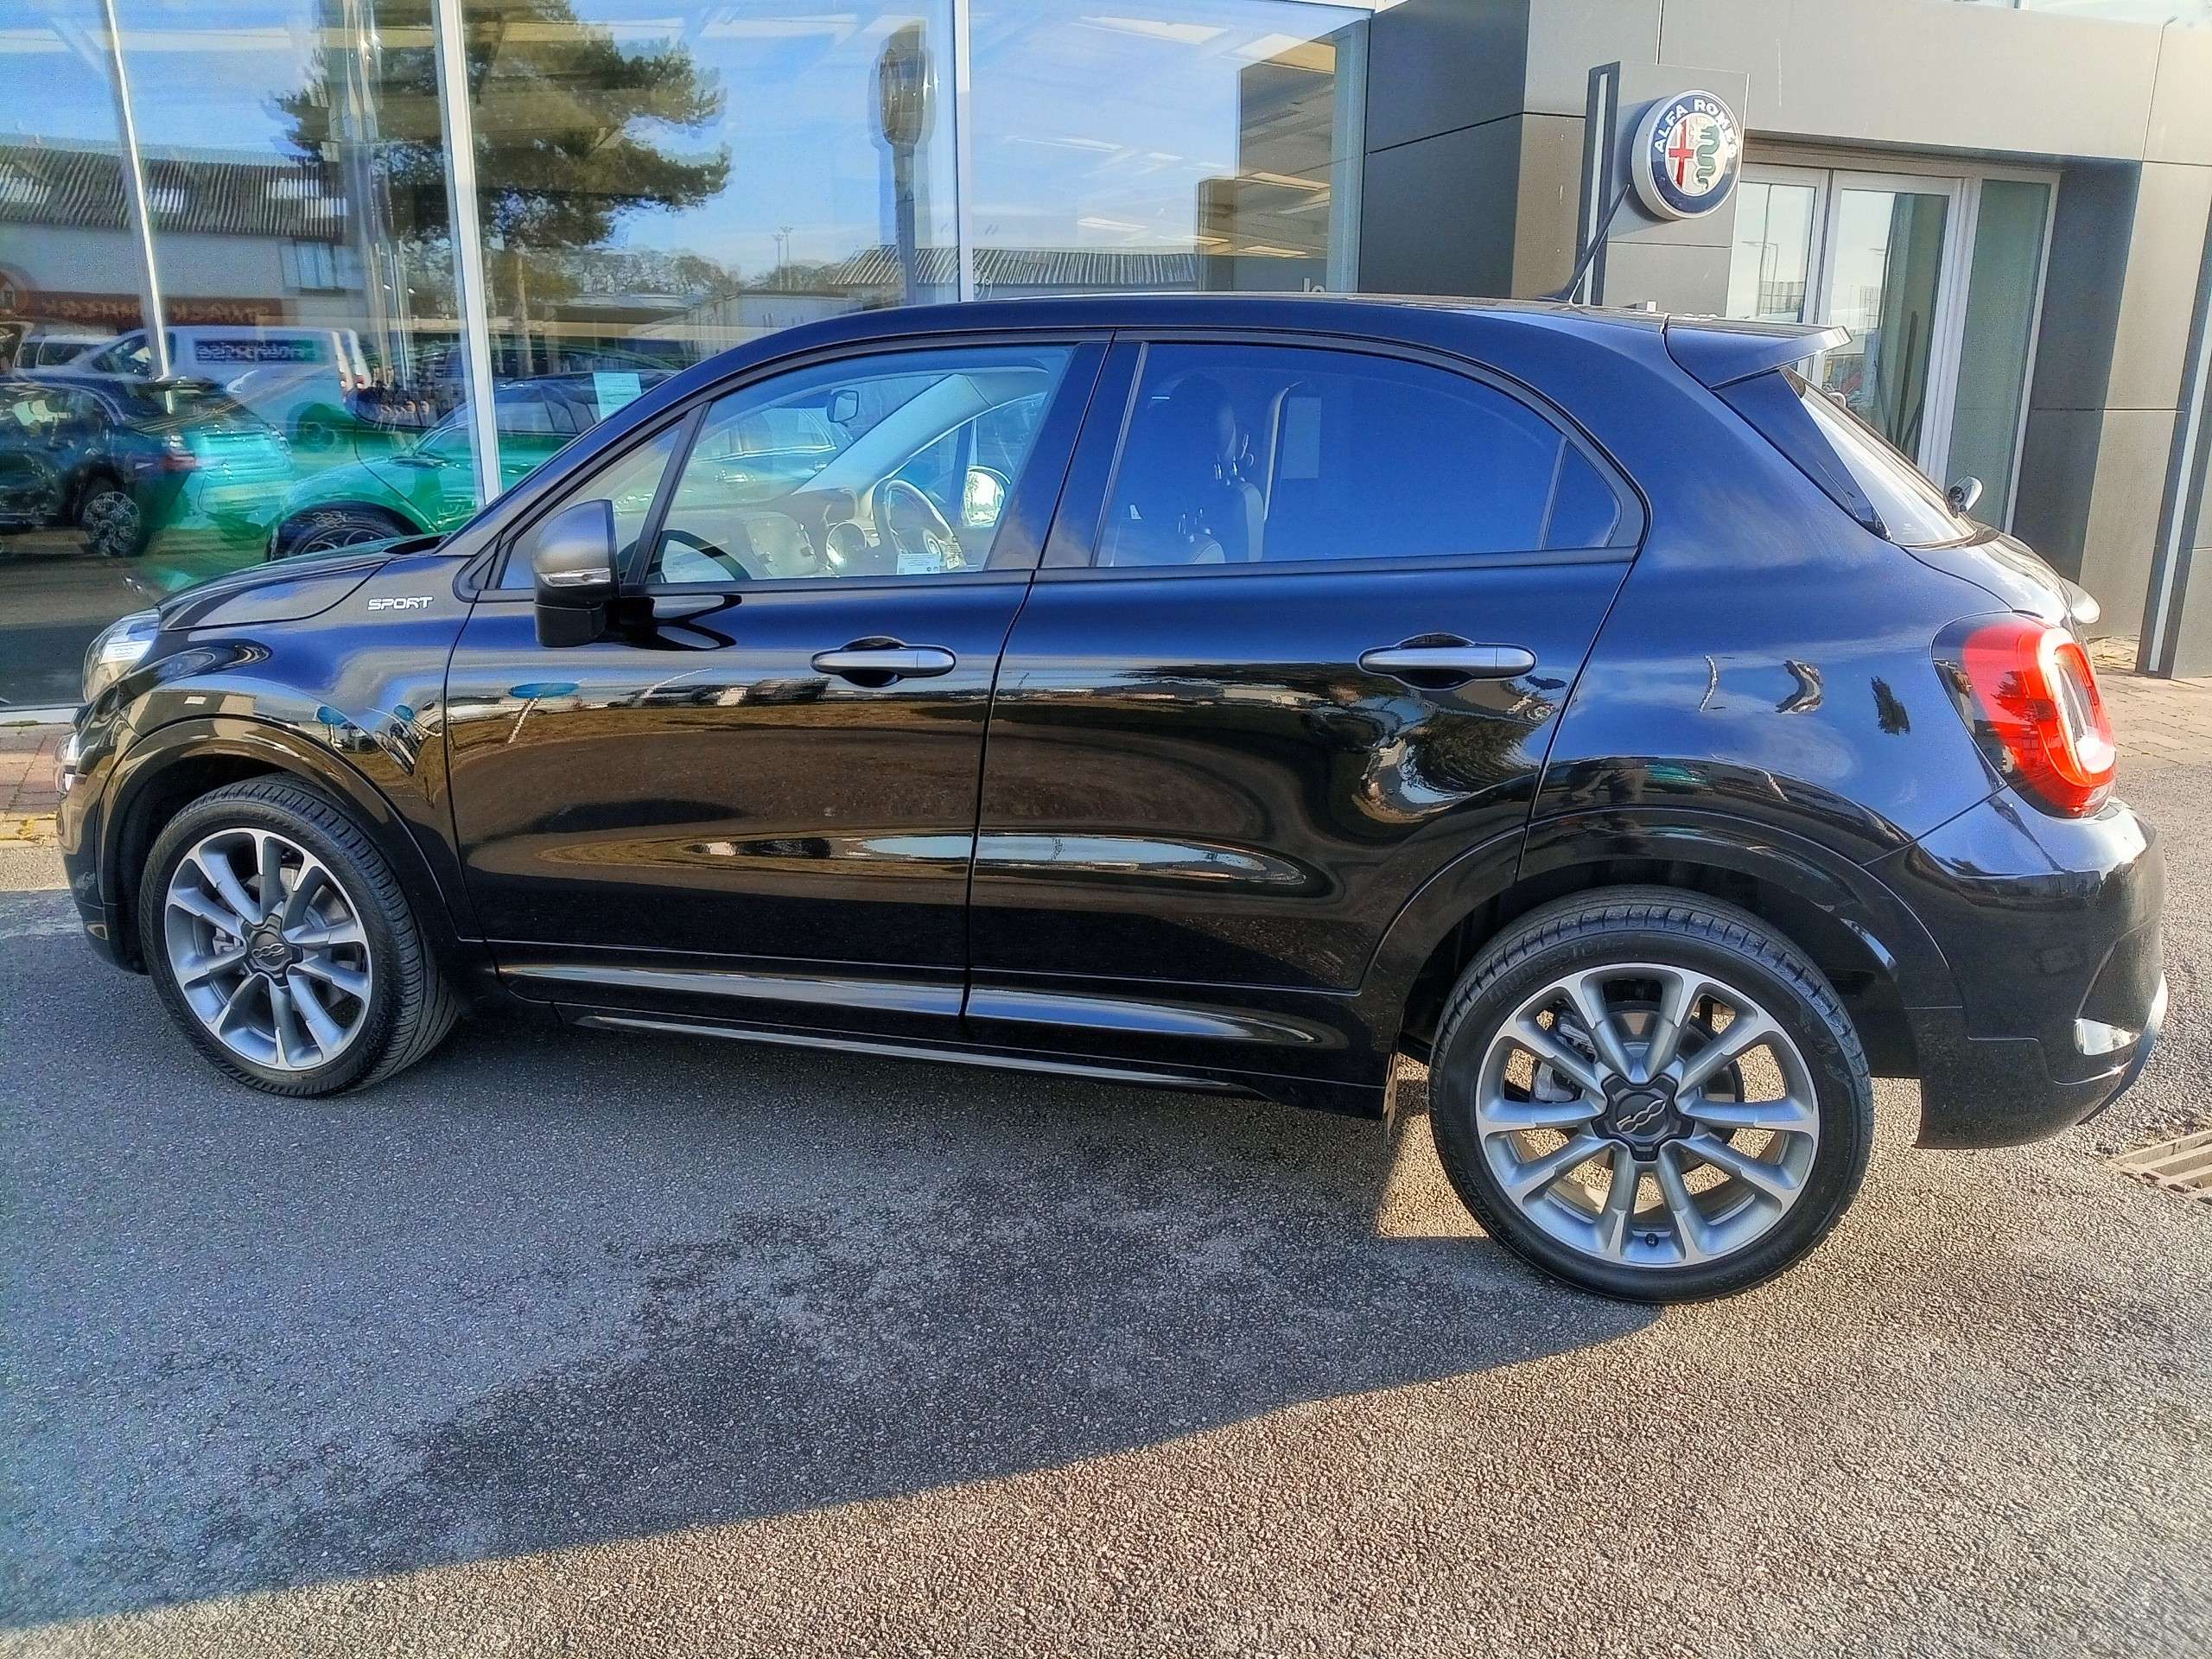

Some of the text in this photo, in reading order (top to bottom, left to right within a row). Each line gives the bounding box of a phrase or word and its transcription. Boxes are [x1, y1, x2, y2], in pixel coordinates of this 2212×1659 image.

[1654, 99, 1738, 159] ALFA ROMEO
[368, 596, 433, 610] SPORT
